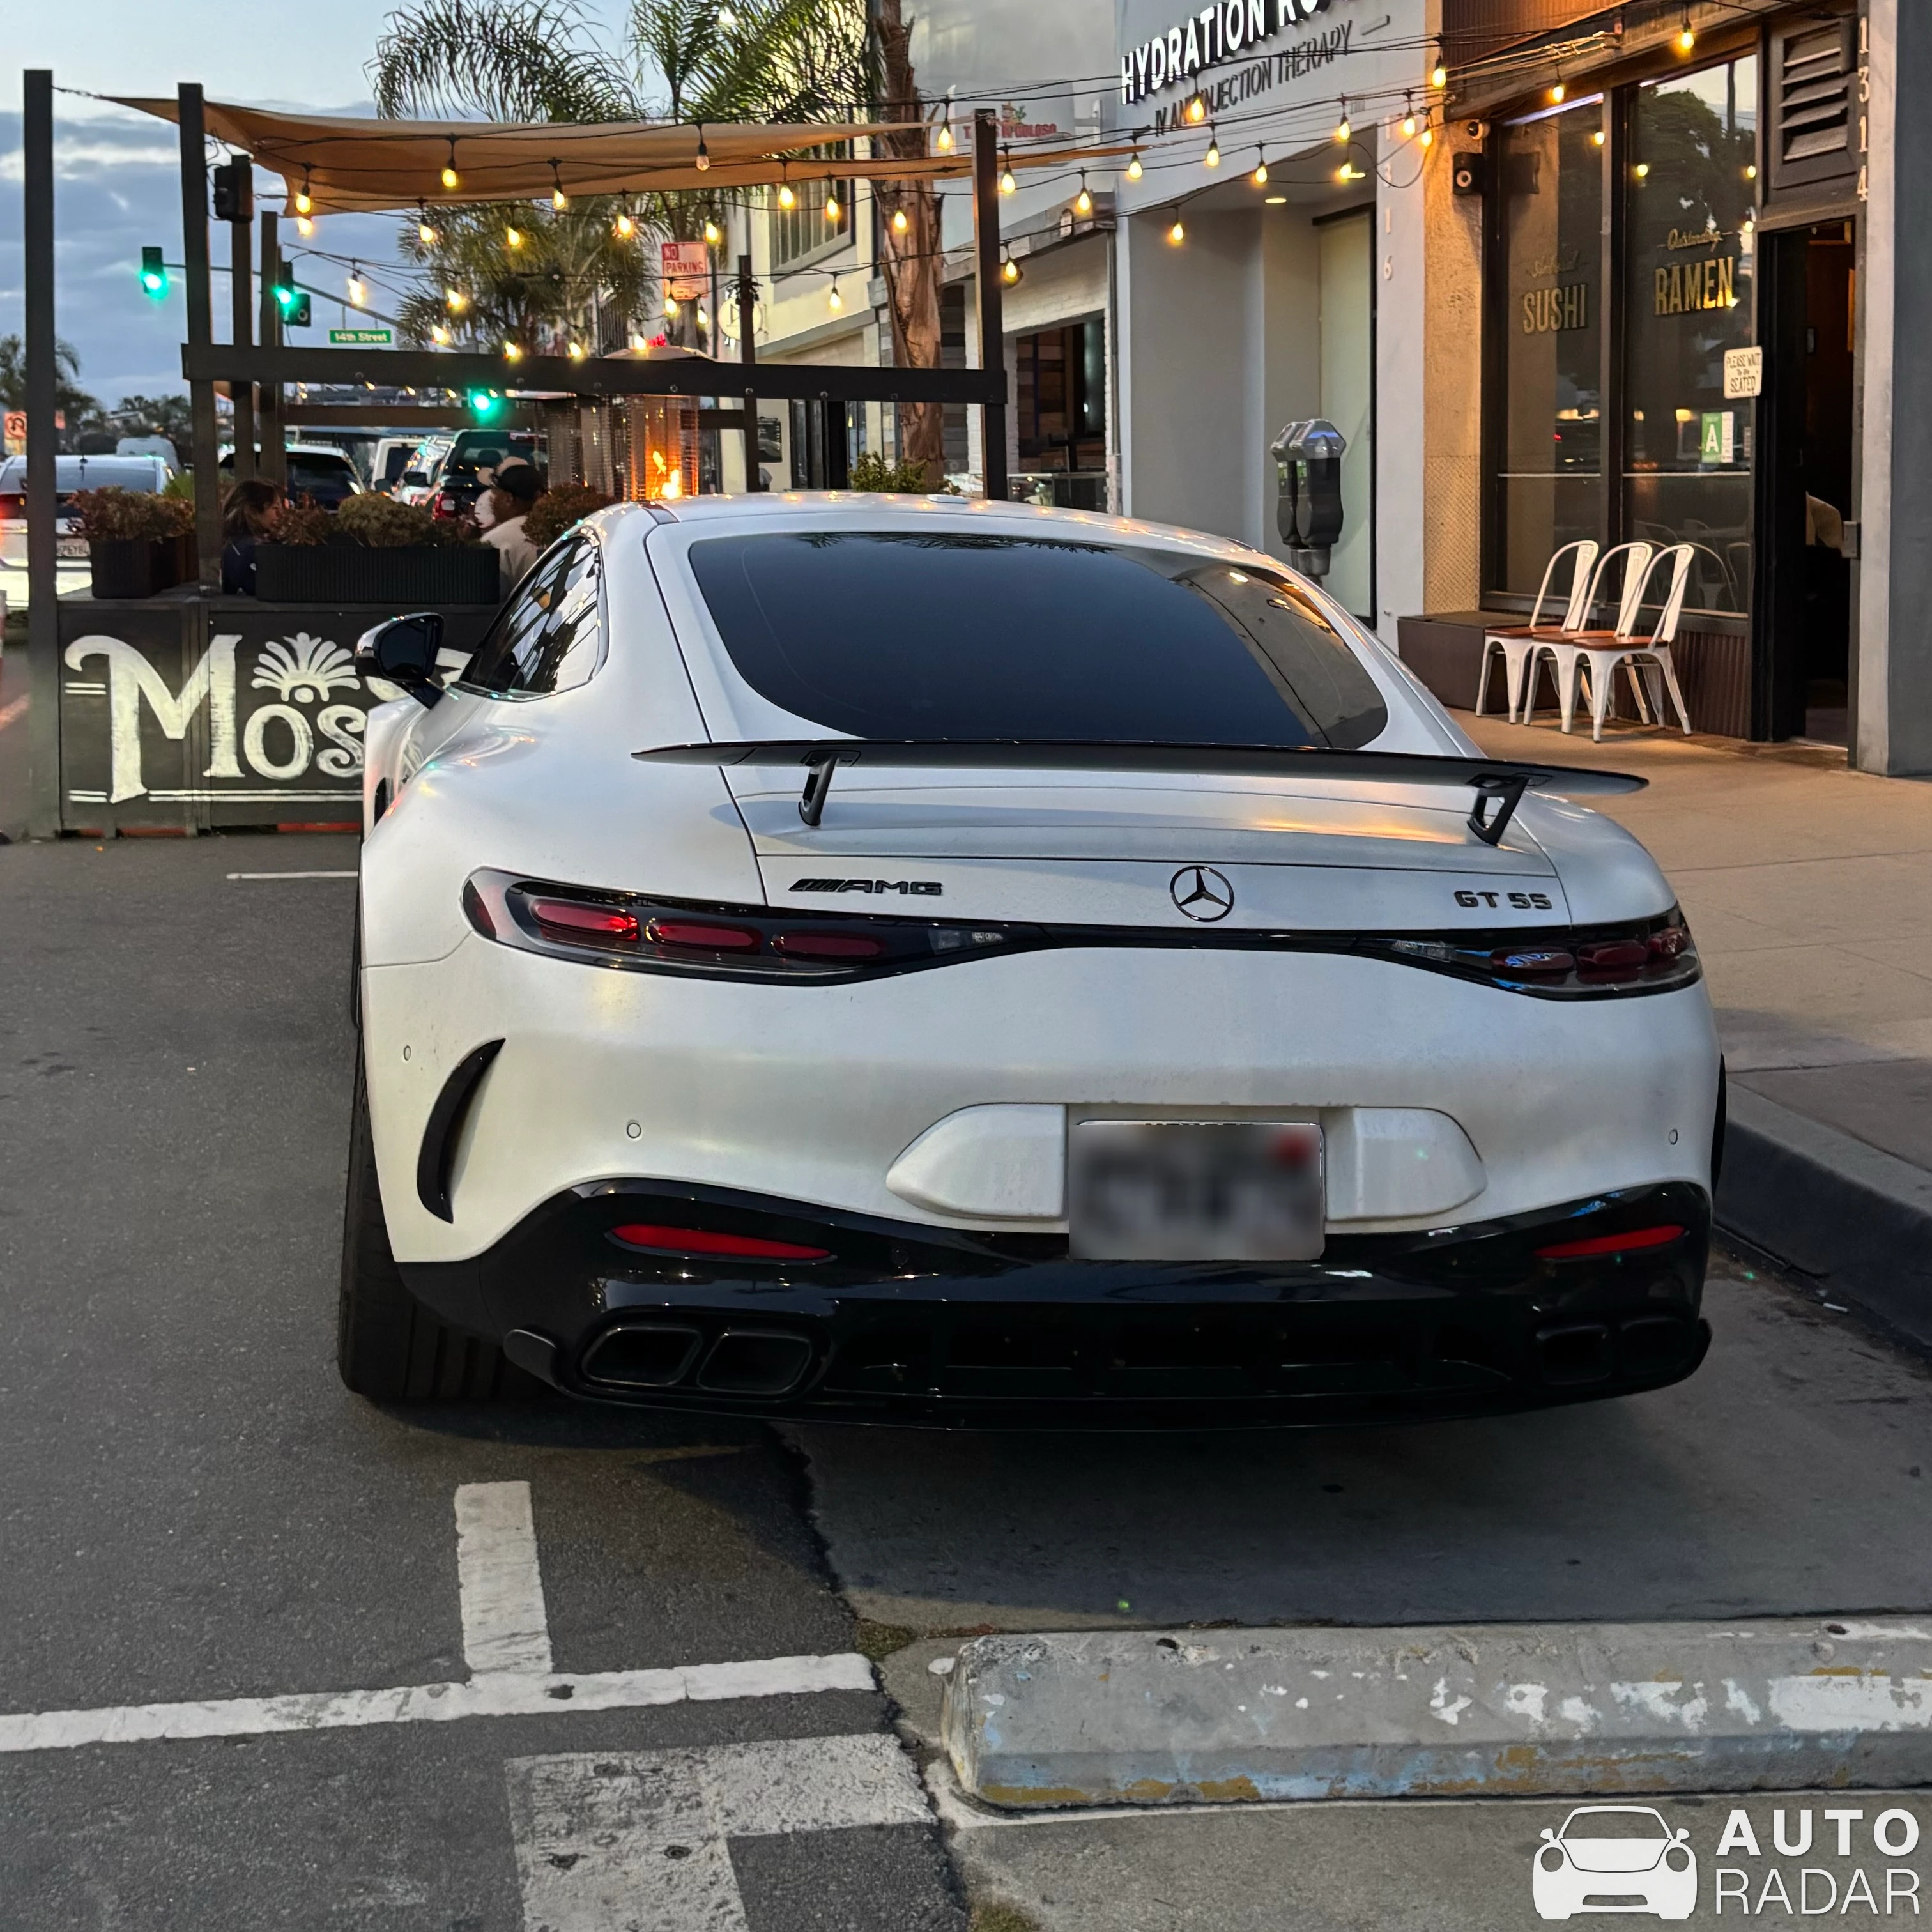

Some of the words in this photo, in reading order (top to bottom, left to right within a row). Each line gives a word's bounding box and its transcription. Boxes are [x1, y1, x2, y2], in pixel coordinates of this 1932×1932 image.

[1121, 0, 1264, 105] HYDRATION
[1278, 20, 1353, 84] THERAPY
[1857, 17, 1869, 202] 1314
[664, 246, 678, 259] NO
[666, 261, 704, 274] PARKING
[1655, 256, 1734, 316] RAMEN
[1523, 284, 1587, 334] SUSHI
[358, 332, 388, 341] Street
[1730, 376, 1756, 393] SEATED
[1705, 424, 1719, 452] A
[838, 879, 942, 896] AMG
[1454, 890, 1499, 908] GT
[1507, 892, 1552, 910] 55
